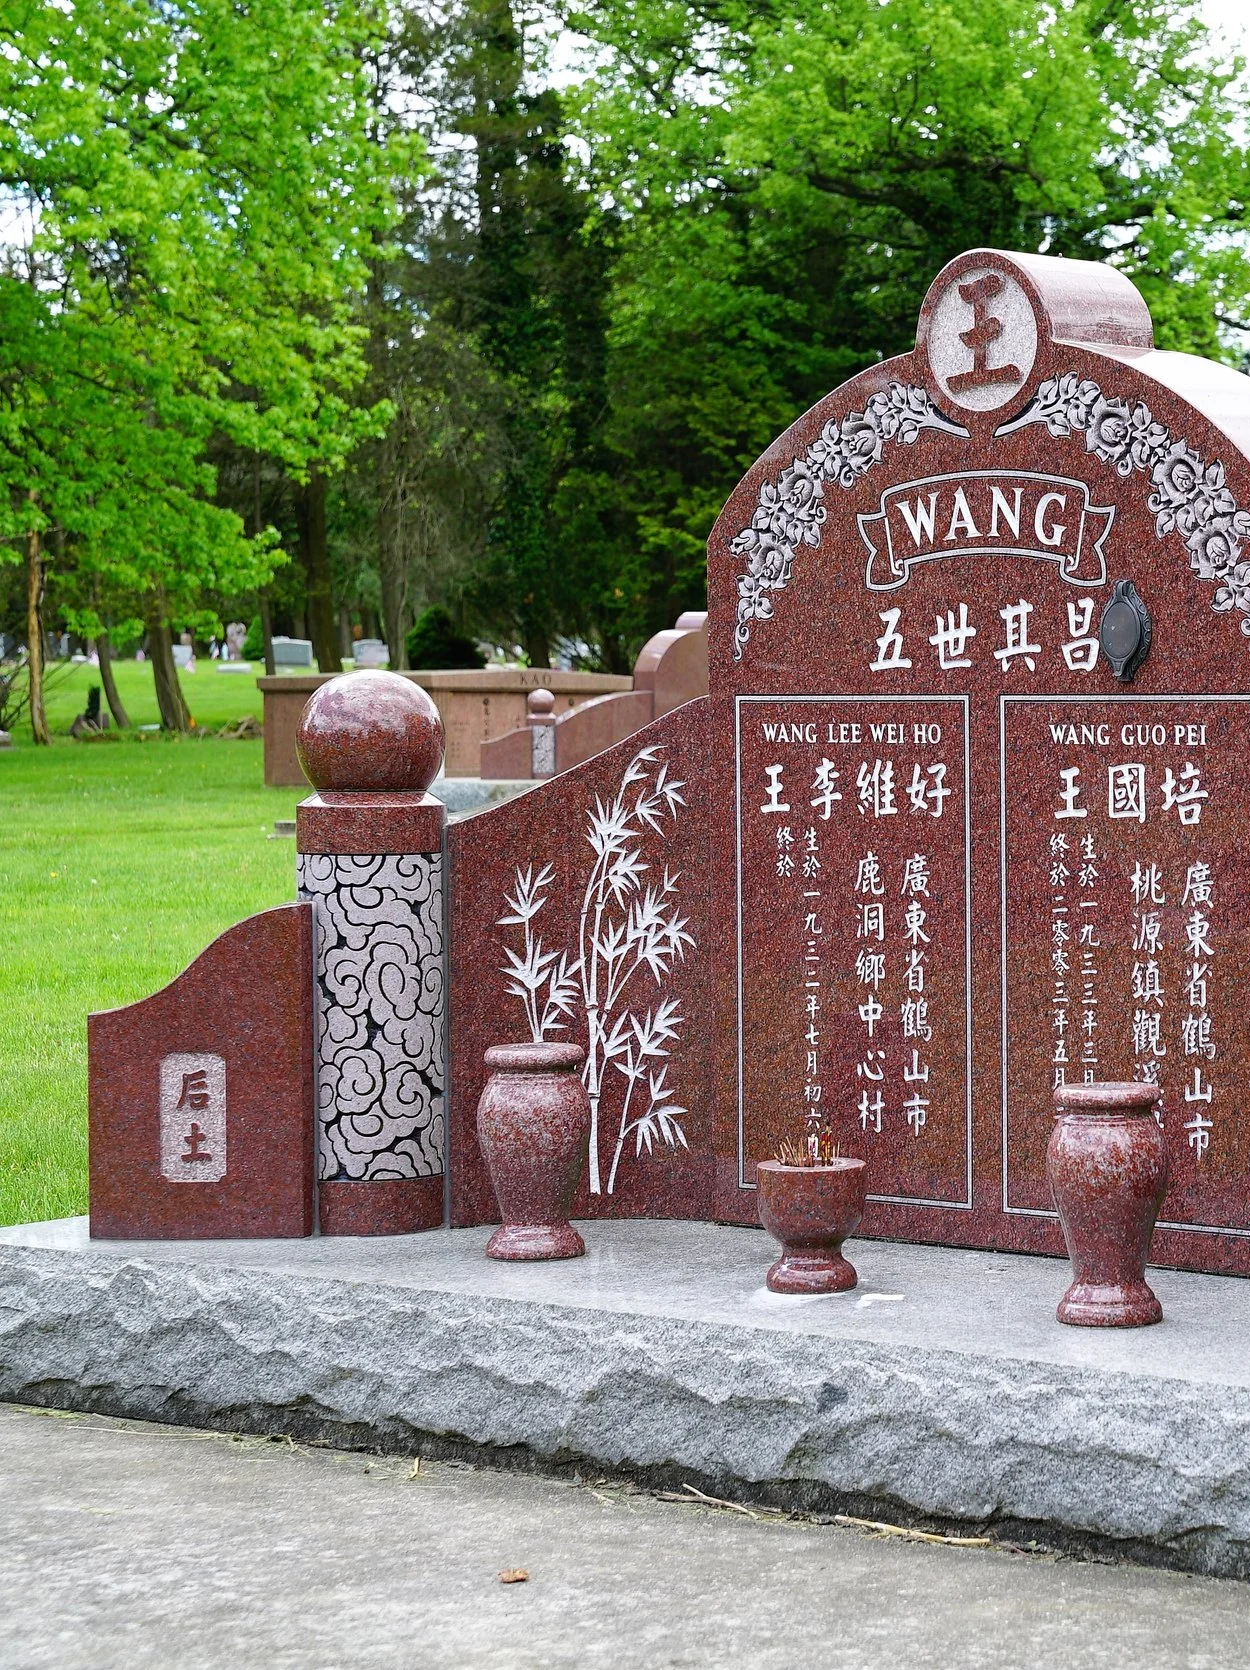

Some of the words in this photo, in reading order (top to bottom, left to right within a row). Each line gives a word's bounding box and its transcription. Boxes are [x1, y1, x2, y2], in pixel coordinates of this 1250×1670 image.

[945, 273, 1022, 396] 王
[894, 485, 1067, 547] WANG
[869, 597, 1099, 673] 五世其昌
[762, 723, 818, 743] WANG
[828, 724, 862, 744] LEE
[869, 724, 905, 744] WEI
[913, 724, 941, 744] HO
[1049, 724, 1110, 746] WANG
[1121, 724, 1166, 746] GUO
[1174, 725, 1207, 746] PEI
[760, 757, 951, 821] 王李維好
[1054, 761, 1209, 826] 王國培
[775, 826, 796, 878] 終於
[854, 850, 886, 1134] 鹿洞鄉中心村
[901, 852, 933, 1137] 廣東省鶴山市
[1181, 860, 1216, 1161] 廣東省鶴山市
[175, 1069, 213, 1164] 后土
